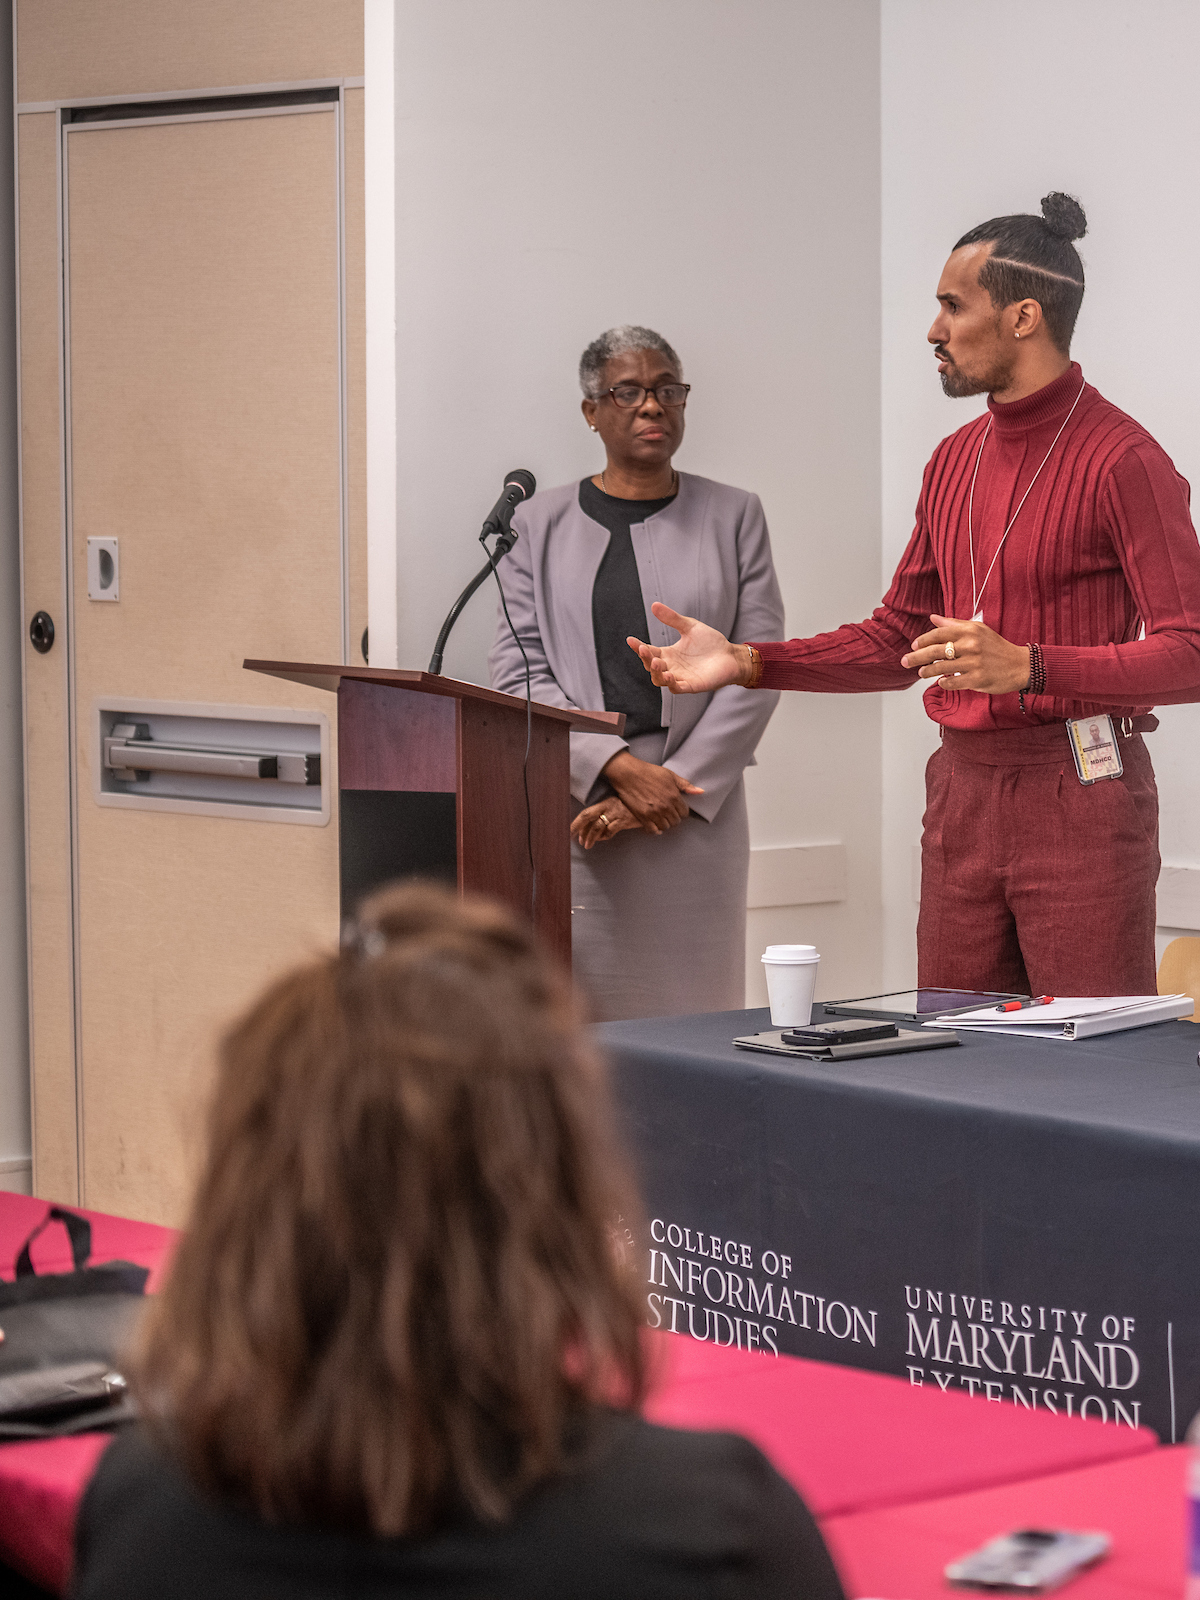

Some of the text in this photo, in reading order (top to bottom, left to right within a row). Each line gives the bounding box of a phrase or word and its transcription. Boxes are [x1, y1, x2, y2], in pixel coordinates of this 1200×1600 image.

[650, 1218, 792, 1279] COLLEGE OF
[646, 1292, 779, 1358] STUDIES
[647, 1248, 878, 1348] INFORMATION
[904, 1284, 1136, 1341] UNIVERSITY OF
[905, 1311, 1140, 1390] MARYLAND
[905, 1365, 1142, 1431] EXTENSION
